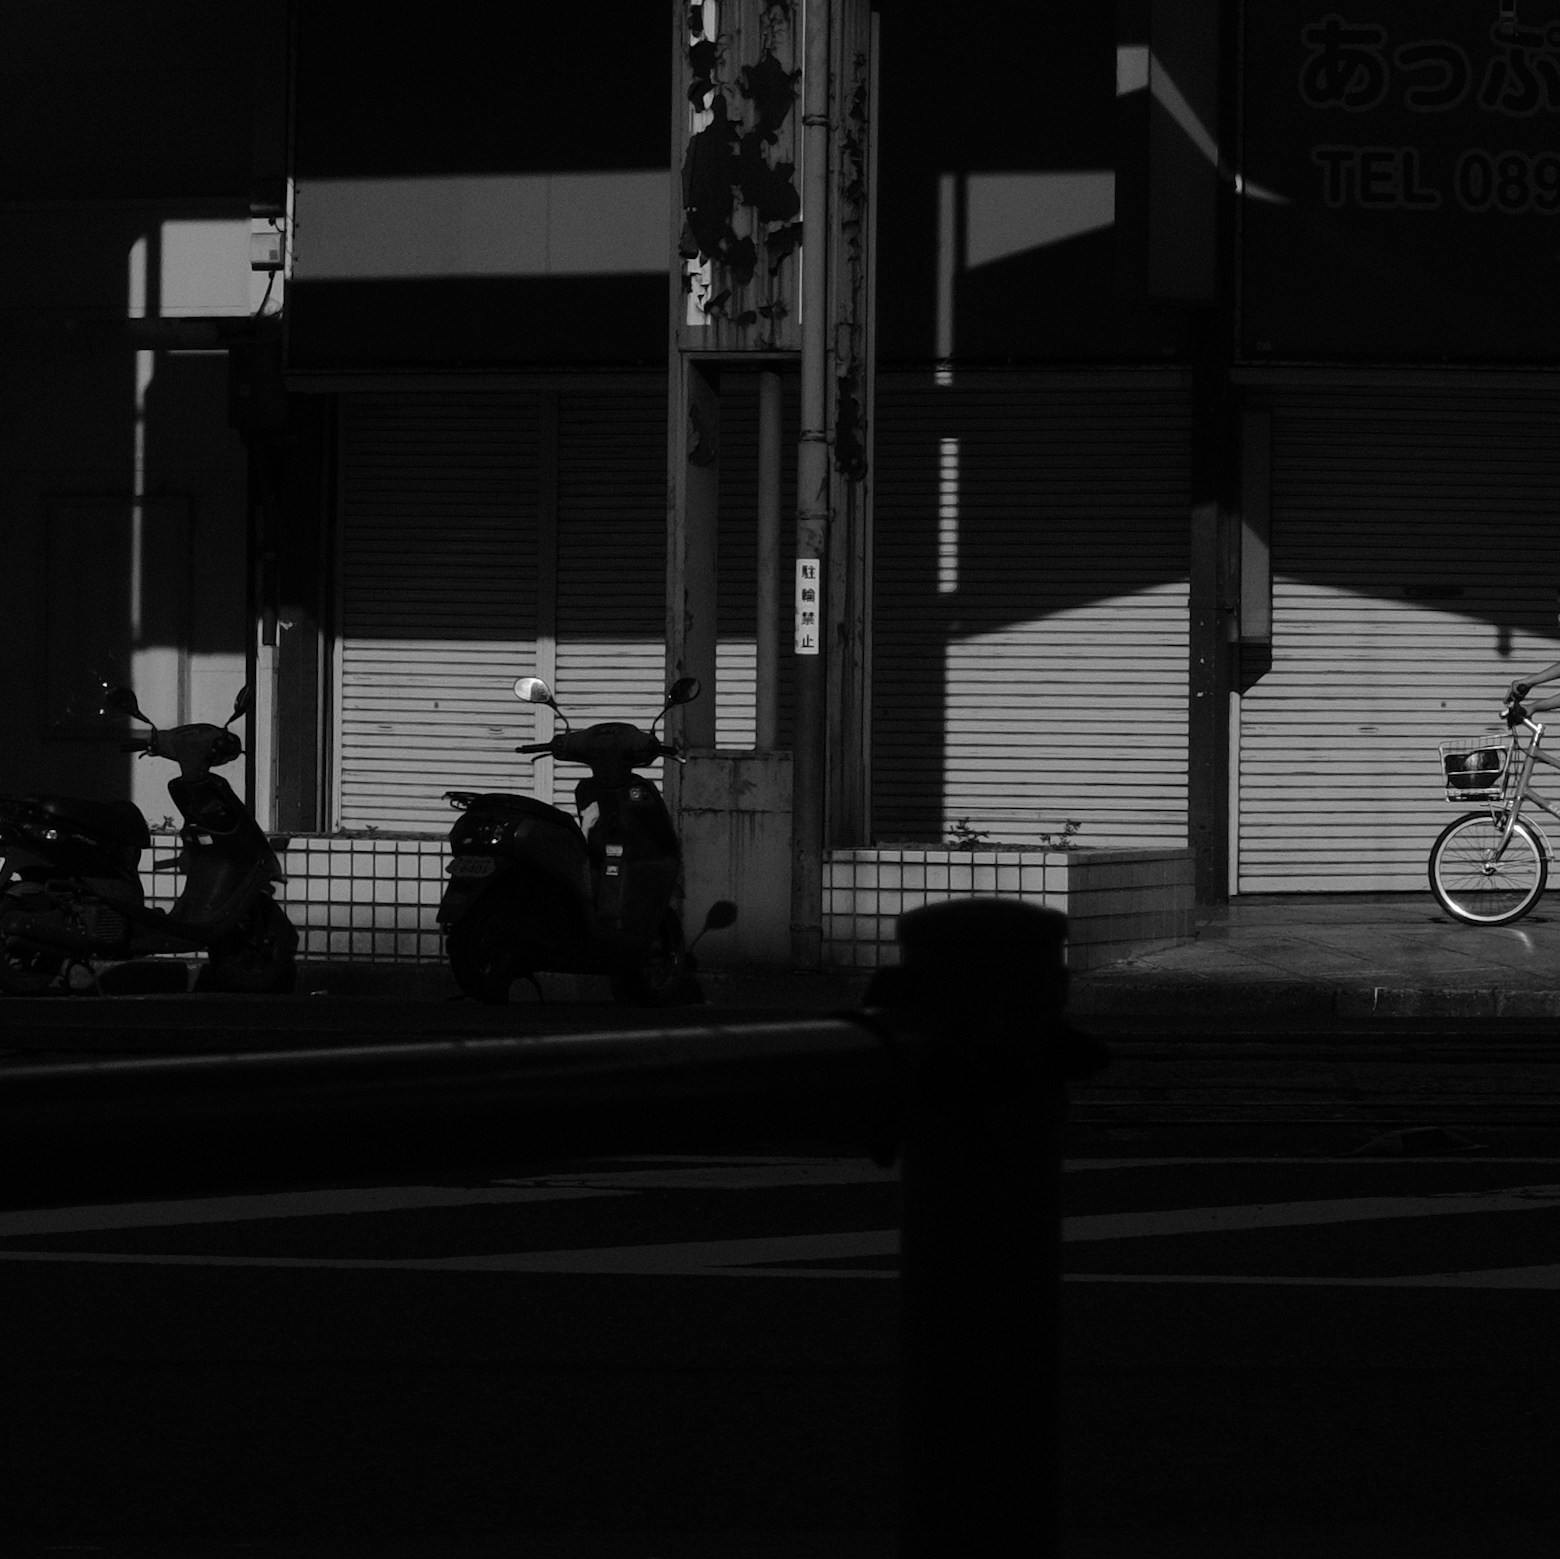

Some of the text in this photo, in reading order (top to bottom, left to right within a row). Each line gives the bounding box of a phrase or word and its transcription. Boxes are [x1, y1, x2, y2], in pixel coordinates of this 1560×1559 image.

[1309, 143, 1441, 209] TEL
[801, 564, 816, 648] 駐輪禁止
